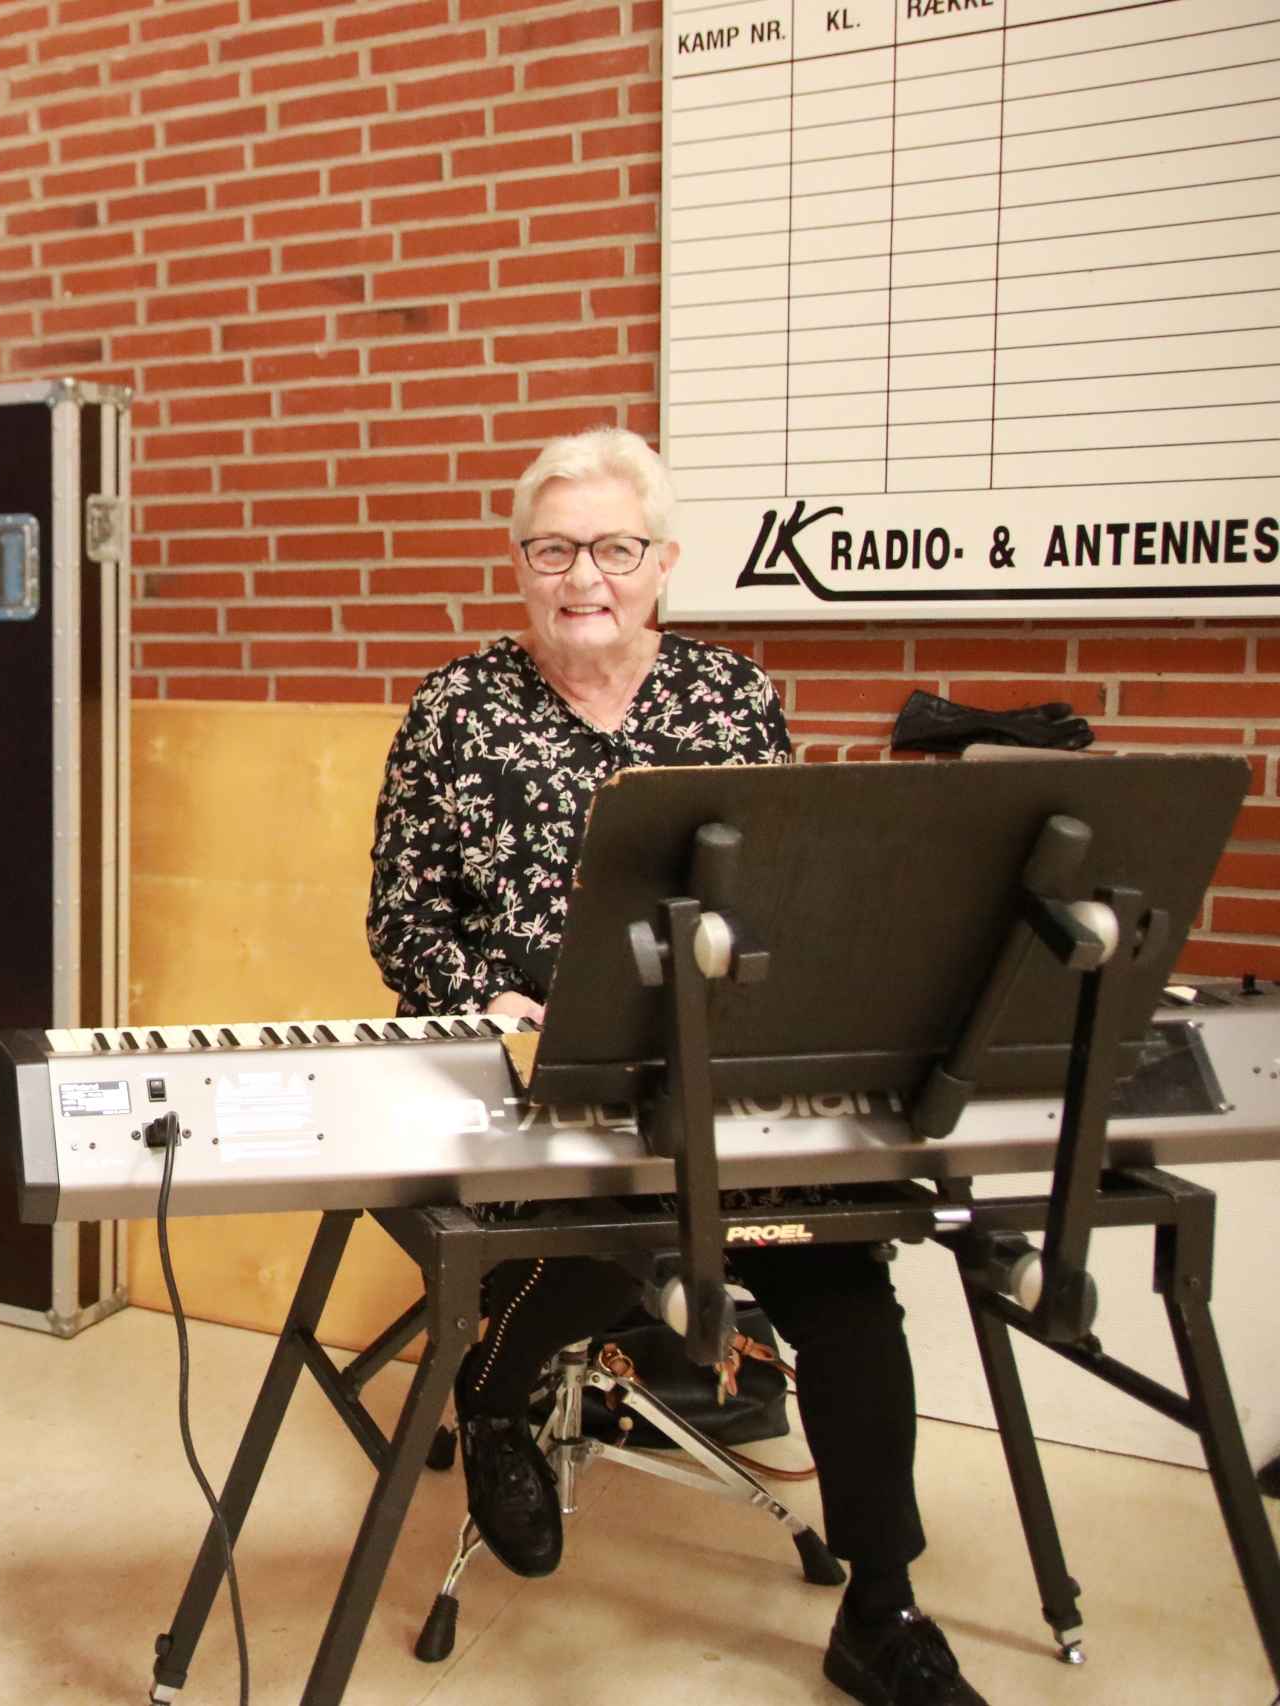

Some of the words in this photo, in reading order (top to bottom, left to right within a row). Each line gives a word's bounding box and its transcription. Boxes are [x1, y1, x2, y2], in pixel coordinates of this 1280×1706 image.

[826, 10, 861, 32] KL.
[678, 26, 740, 54] KAMP
[750, 20, 787, 44] NR.
[989, 525, 1016, 568] &
[1043, 517, 1280, 567] ANTENNES
[725, 1224, 814, 1246] PROEL
